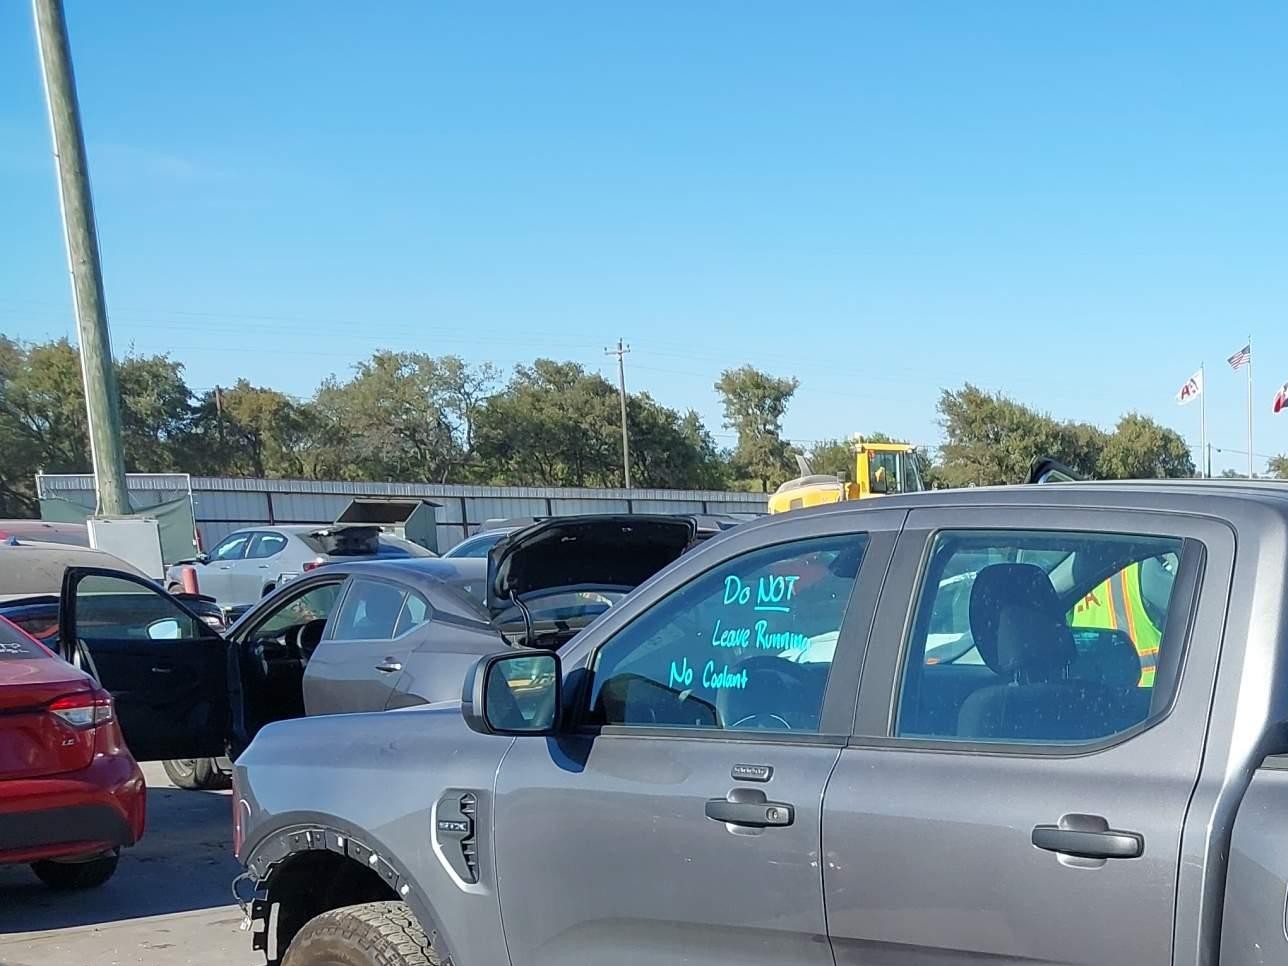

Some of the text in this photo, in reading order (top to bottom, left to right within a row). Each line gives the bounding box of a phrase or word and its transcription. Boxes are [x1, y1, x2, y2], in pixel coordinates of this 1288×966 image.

[724, 575, 800, 605] Do NOT
[712, 619, 811, 650] Leave Running
[669, 657, 749, 689] No Coolant
